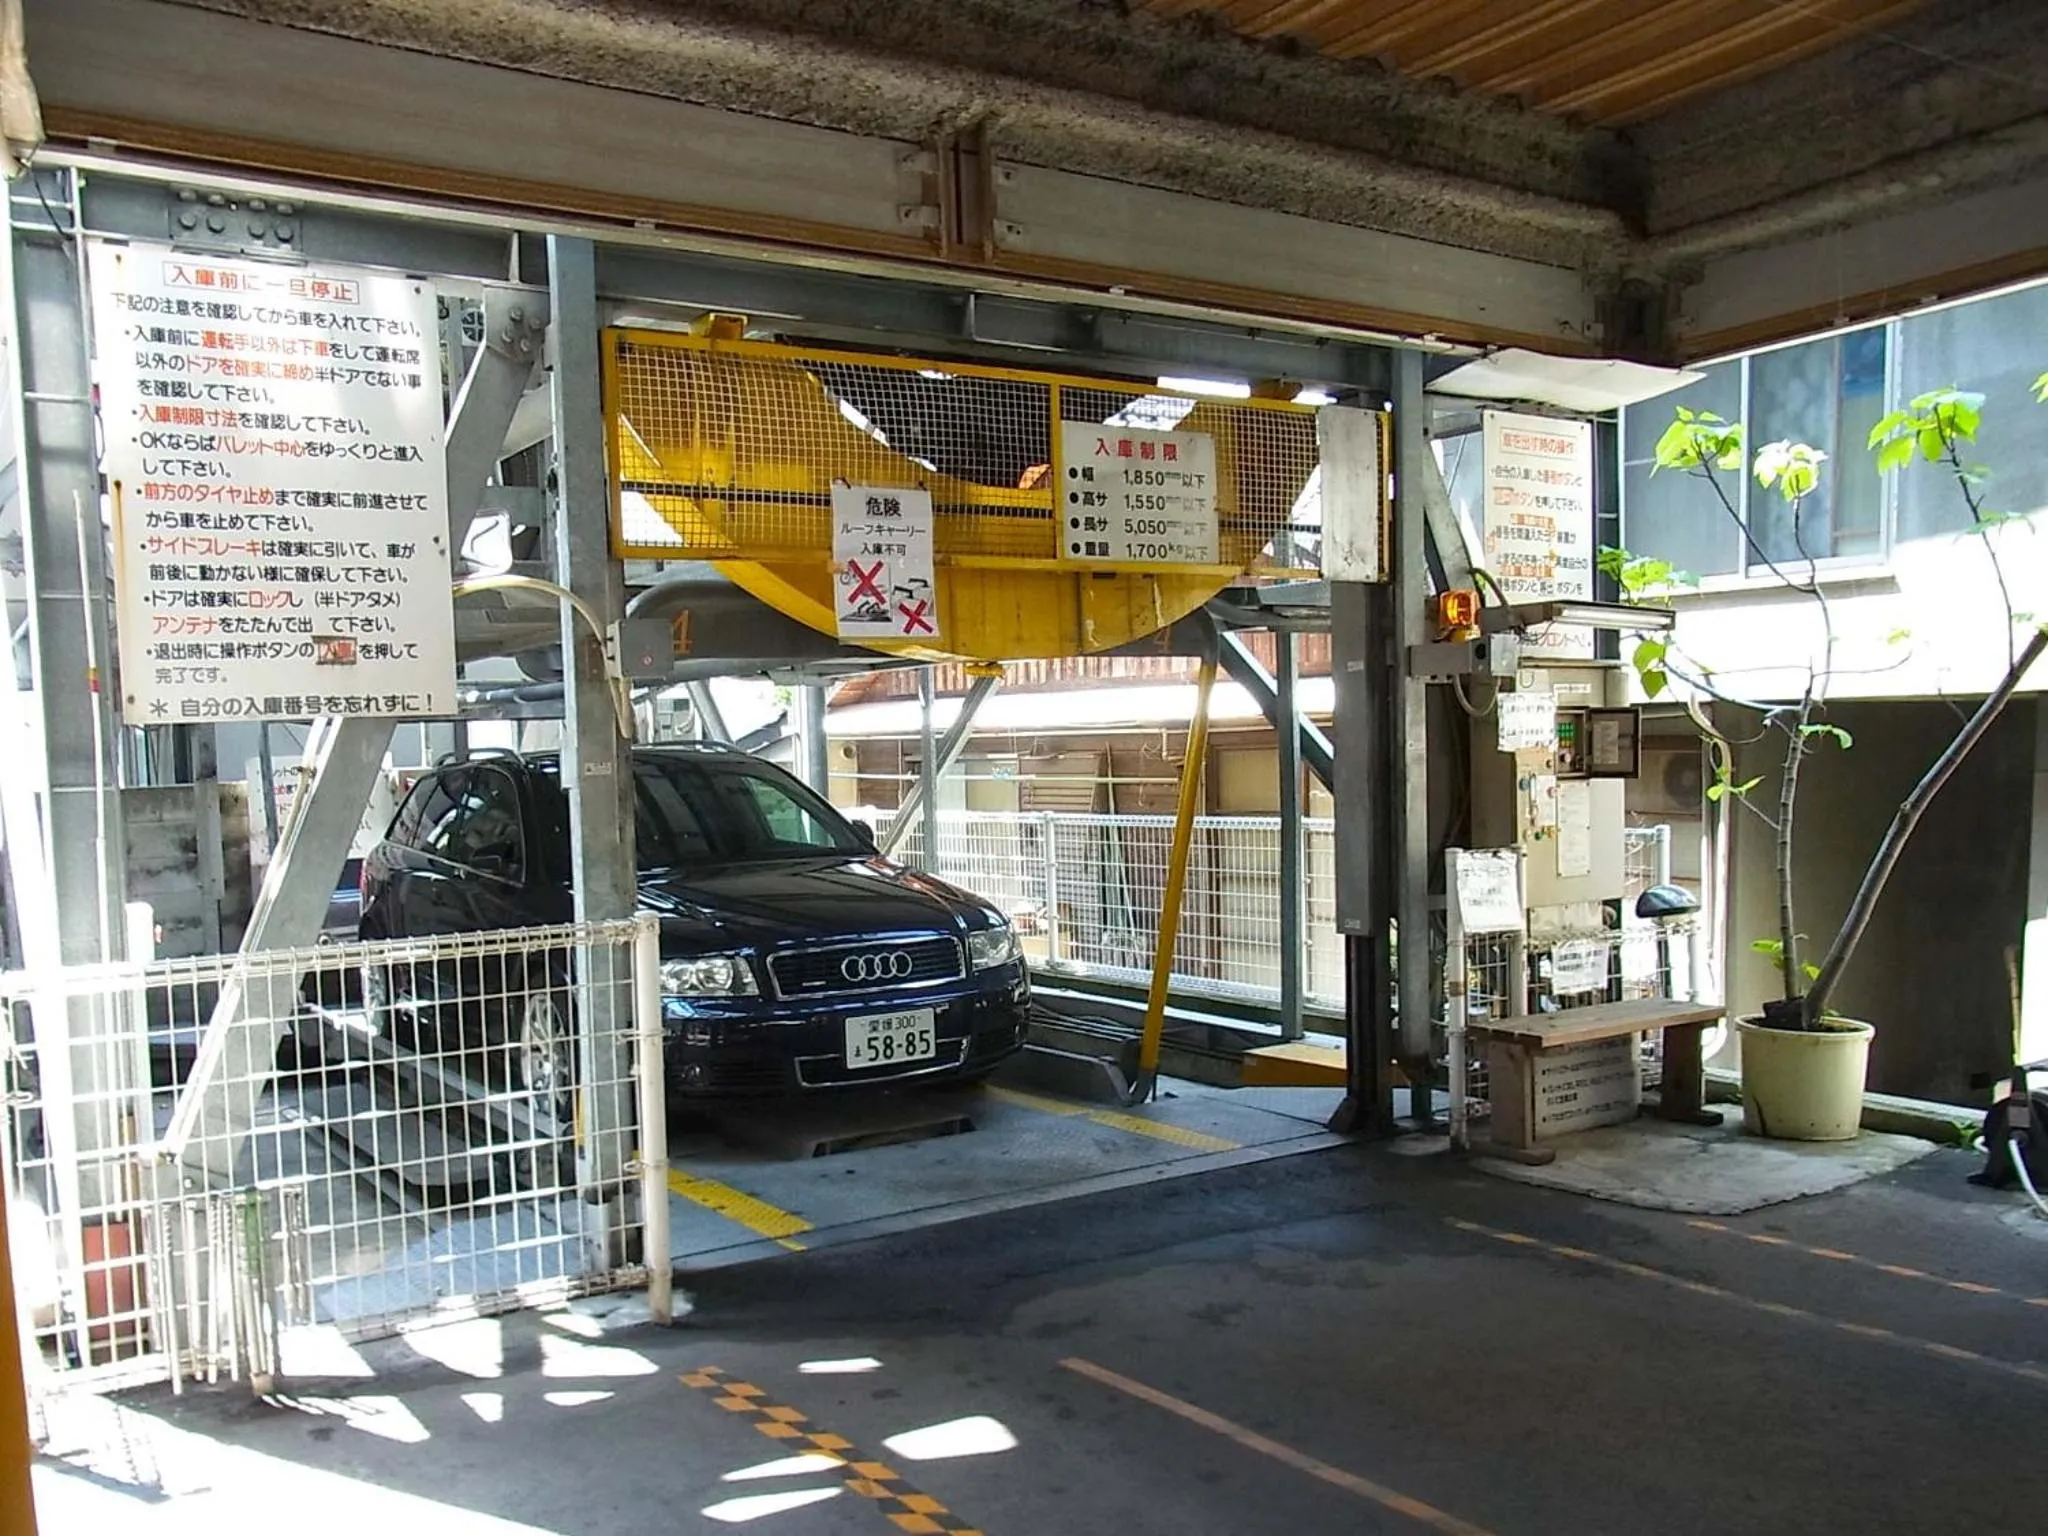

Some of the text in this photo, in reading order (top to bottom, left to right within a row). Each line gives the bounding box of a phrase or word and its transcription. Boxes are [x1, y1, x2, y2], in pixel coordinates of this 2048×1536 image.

[173, 263, 352, 301] 入庫前に一旦停止
[111, 292, 420, 337] 下記の注意を確認してから車を入れて下さい。
[137, 379, 275, 404] を確認して下さい。
[1095, 438, 1178, 462] 入庫制限
[142, 457, 232, 479] して下さい。
[866, 496, 902, 517] 危険
[145, 511, 314, 532] から車を止めて下さい。
[861, 543, 907, 556] 入庫不可
[149, 563, 409, 584] 前後に動かない様に確保して下さい。
[155, 667, 228, 685] 完了です。
[895, 1016, 916, 1030] 300
[867, 1029, 931, 1062] 58-85
